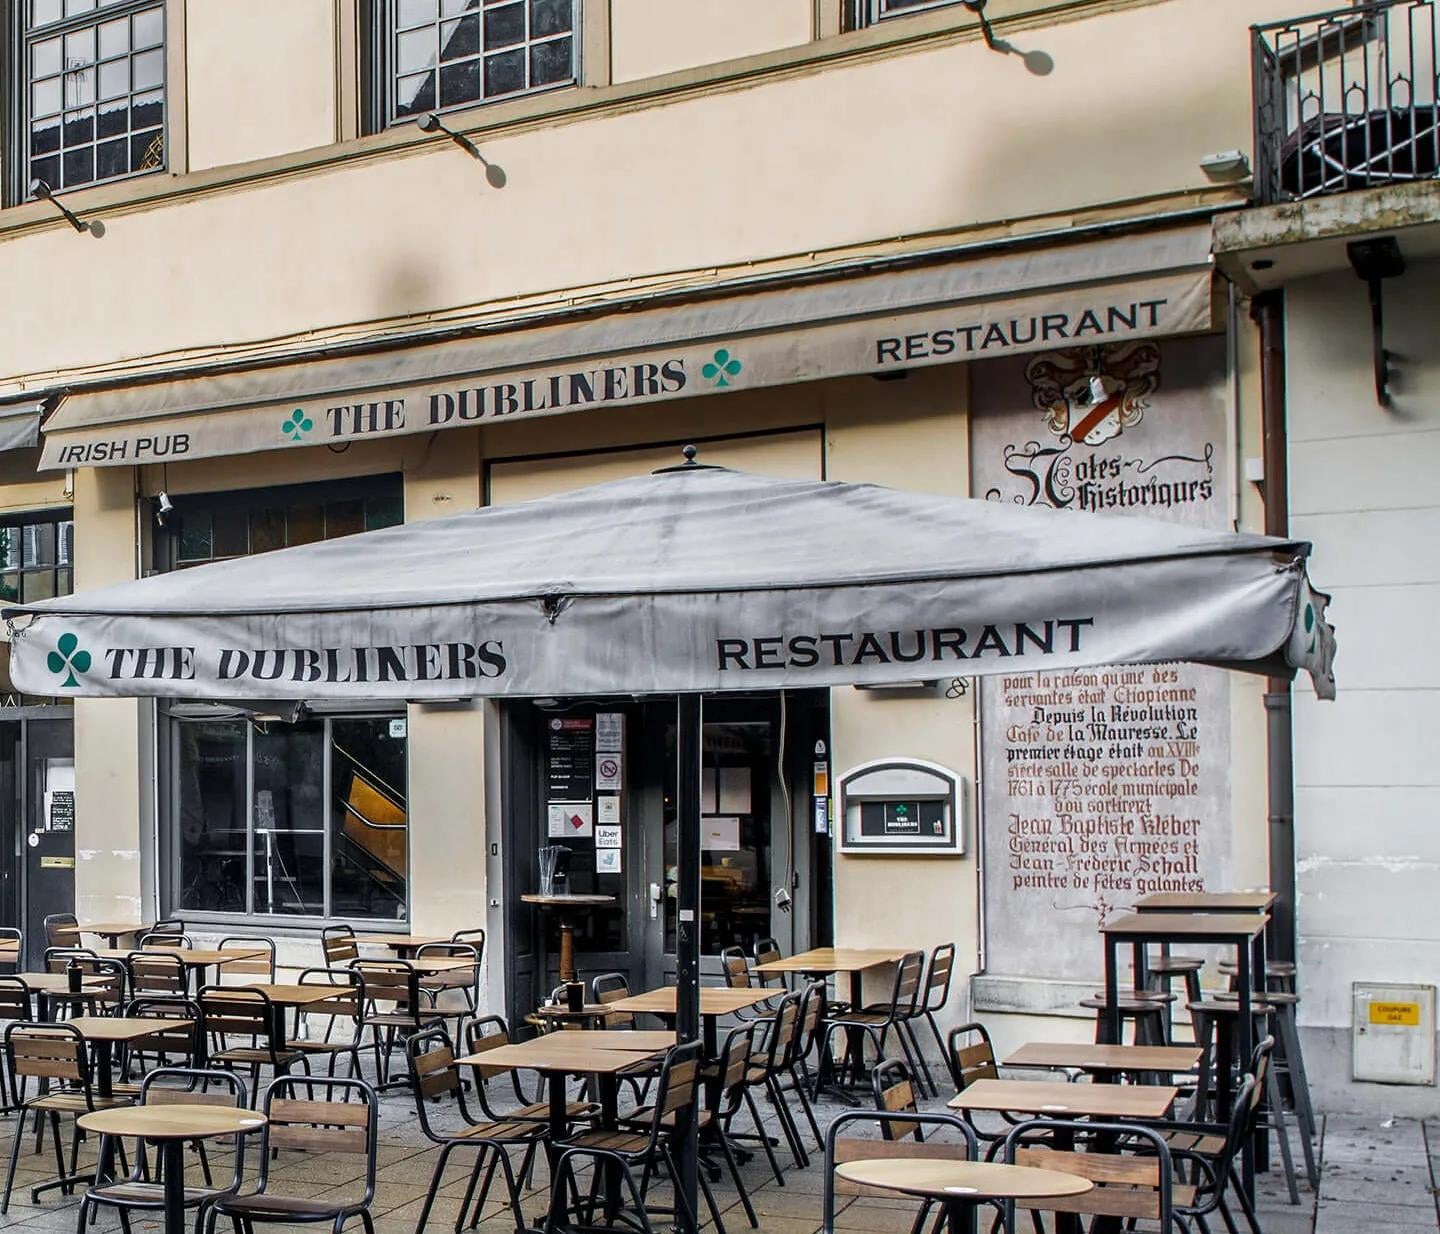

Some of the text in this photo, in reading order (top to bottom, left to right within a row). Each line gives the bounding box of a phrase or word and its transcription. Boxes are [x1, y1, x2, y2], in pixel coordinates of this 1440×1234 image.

[875, 299, 1168, 364] RESTAURANT
[326, 358, 687, 436] THE DUBLINERS
[58, 434, 190, 464] IRISH PUB
[716, 617, 1094, 671] RESTAURANT
[105, 640, 507, 683] THE DUBLINERS
[1003, 676, 1033, 694] pour
[1152, 668, 1178, 684] des
[1005, 690, 1072, 707] servantes
[1031, 704, 1198, 726] Depuis la Révolution
[1046, 725, 1064, 742] de
[1069, 724, 1085, 741] la
[1176, 721, 1198, 740] Le
[1006, 745, 1060, 763] premier
[1064, 744, 1103, 763] étage
[1109, 742, 1144, 759] était
[1148, 746, 1164, 758] au
[1045, 761, 1078, 777] salle
[1083, 761, 1098, 777] de
[1102, 760, 1175, 779] spectacles
[1178, 758, 1199, 777] De
[1008, 779, 1033, 796] 1761
[1050, 779, 1082, 797] 1775
[1121, 779, 1198, 799] municipale
[1088, 797, 1152, 814] sortirent
[598, 829, 618, 838] Uber
[1008, 813, 1052, 835] Jean
[1056, 813, 1134, 838] Baptiste
[1009, 834, 1074, 854] Général
[1080, 834, 1107, 853] des
[1184, 839, 1199, 855] et
[1133, 853, 1198, 878] Schall
[1013, 872, 1068, 890] peintre
[1073, 872, 1089, 889] de
[1094, 873, 1131, 893] fêtes
